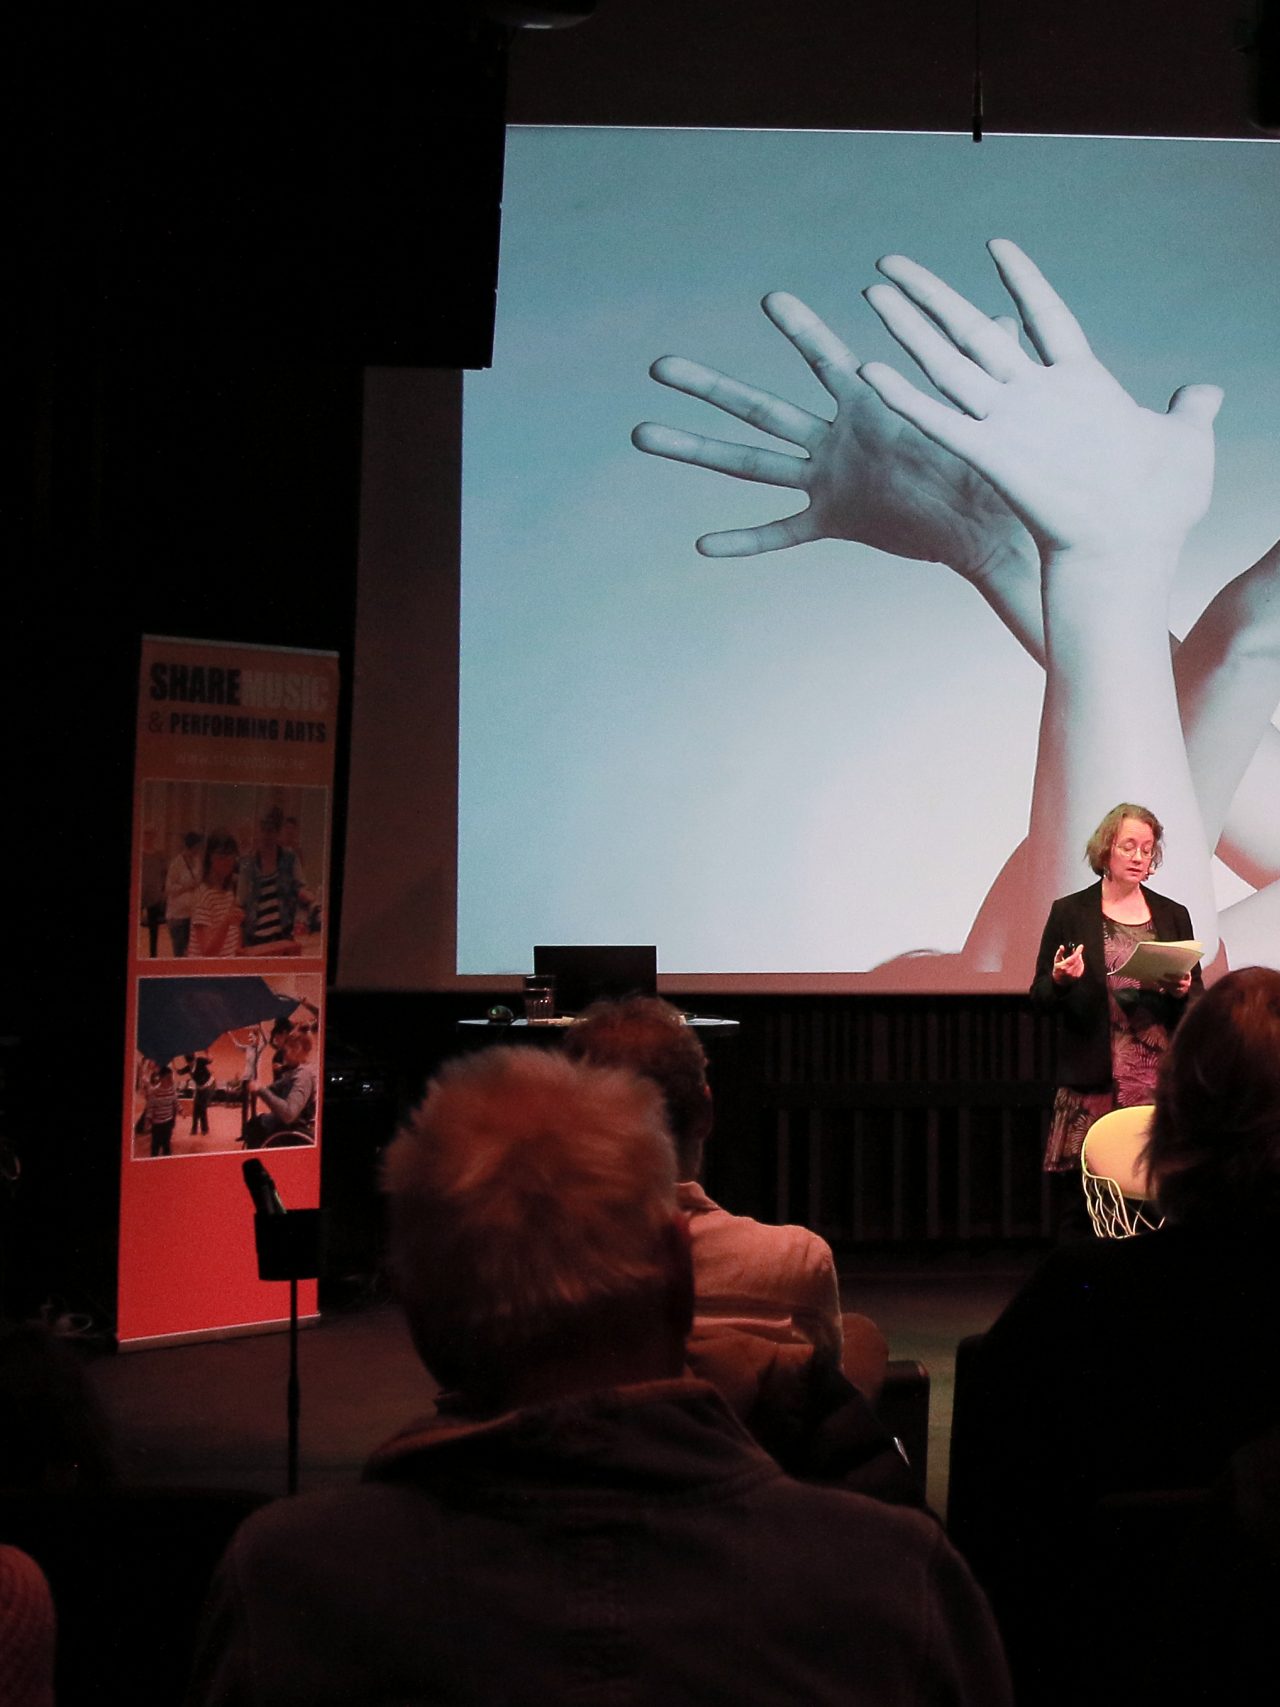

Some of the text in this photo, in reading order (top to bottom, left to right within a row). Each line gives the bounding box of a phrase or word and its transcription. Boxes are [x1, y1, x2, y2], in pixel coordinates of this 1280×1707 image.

[148, 711, 327, 743] & PERFORMING ARTS
